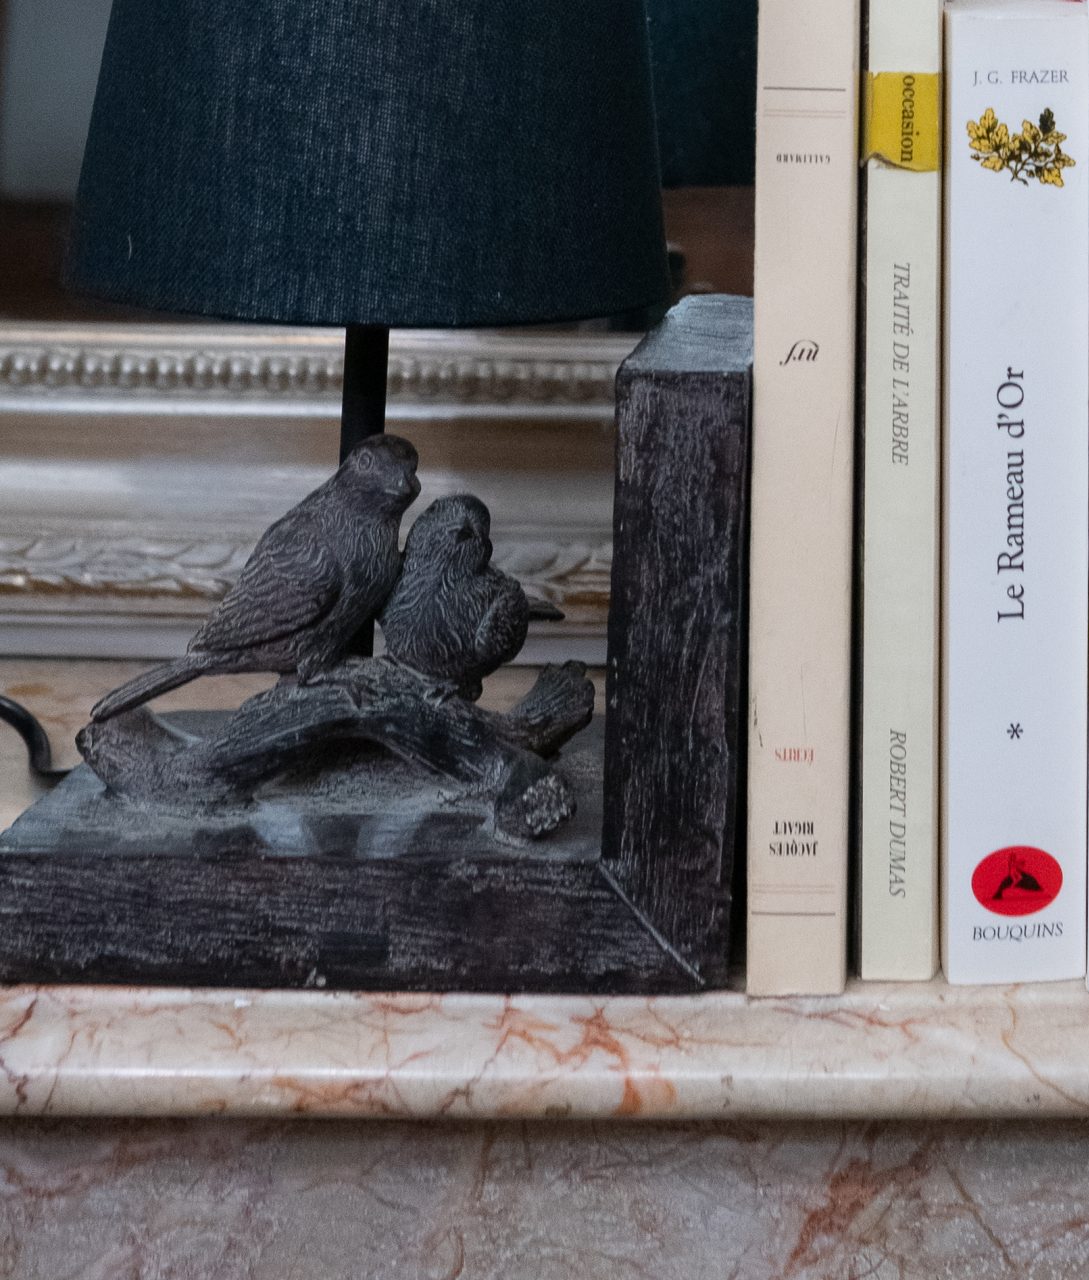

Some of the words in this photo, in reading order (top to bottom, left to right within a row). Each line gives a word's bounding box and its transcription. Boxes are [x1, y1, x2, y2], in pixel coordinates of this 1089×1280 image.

[973, 70, 982, 87] J.
[987, 70, 1003, 85] G.
[1011, 70, 1070, 84] FRAZER
[900, 75, 920, 163] occasion
[776, 153, 831, 164] GALLIMARD
[893, 262, 914, 335] TRAITÉ
[779, 339, 820, 366] nrf
[892, 340, 910, 373] DE
[892, 378, 910, 466] L'ARBRE
[997, 366, 1025, 439] d'Or
[997, 449, 1025, 574] Rameau
[997, 584, 1025, 623] Le
[889, 728, 907, 818] ROBERT
[769, 839, 819, 856] JACQUES
[773, 821, 815, 835] RIGAUT
[889, 820, 907, 899] DUMAS
[973, 922, 1064, 942] BOUQUINS
